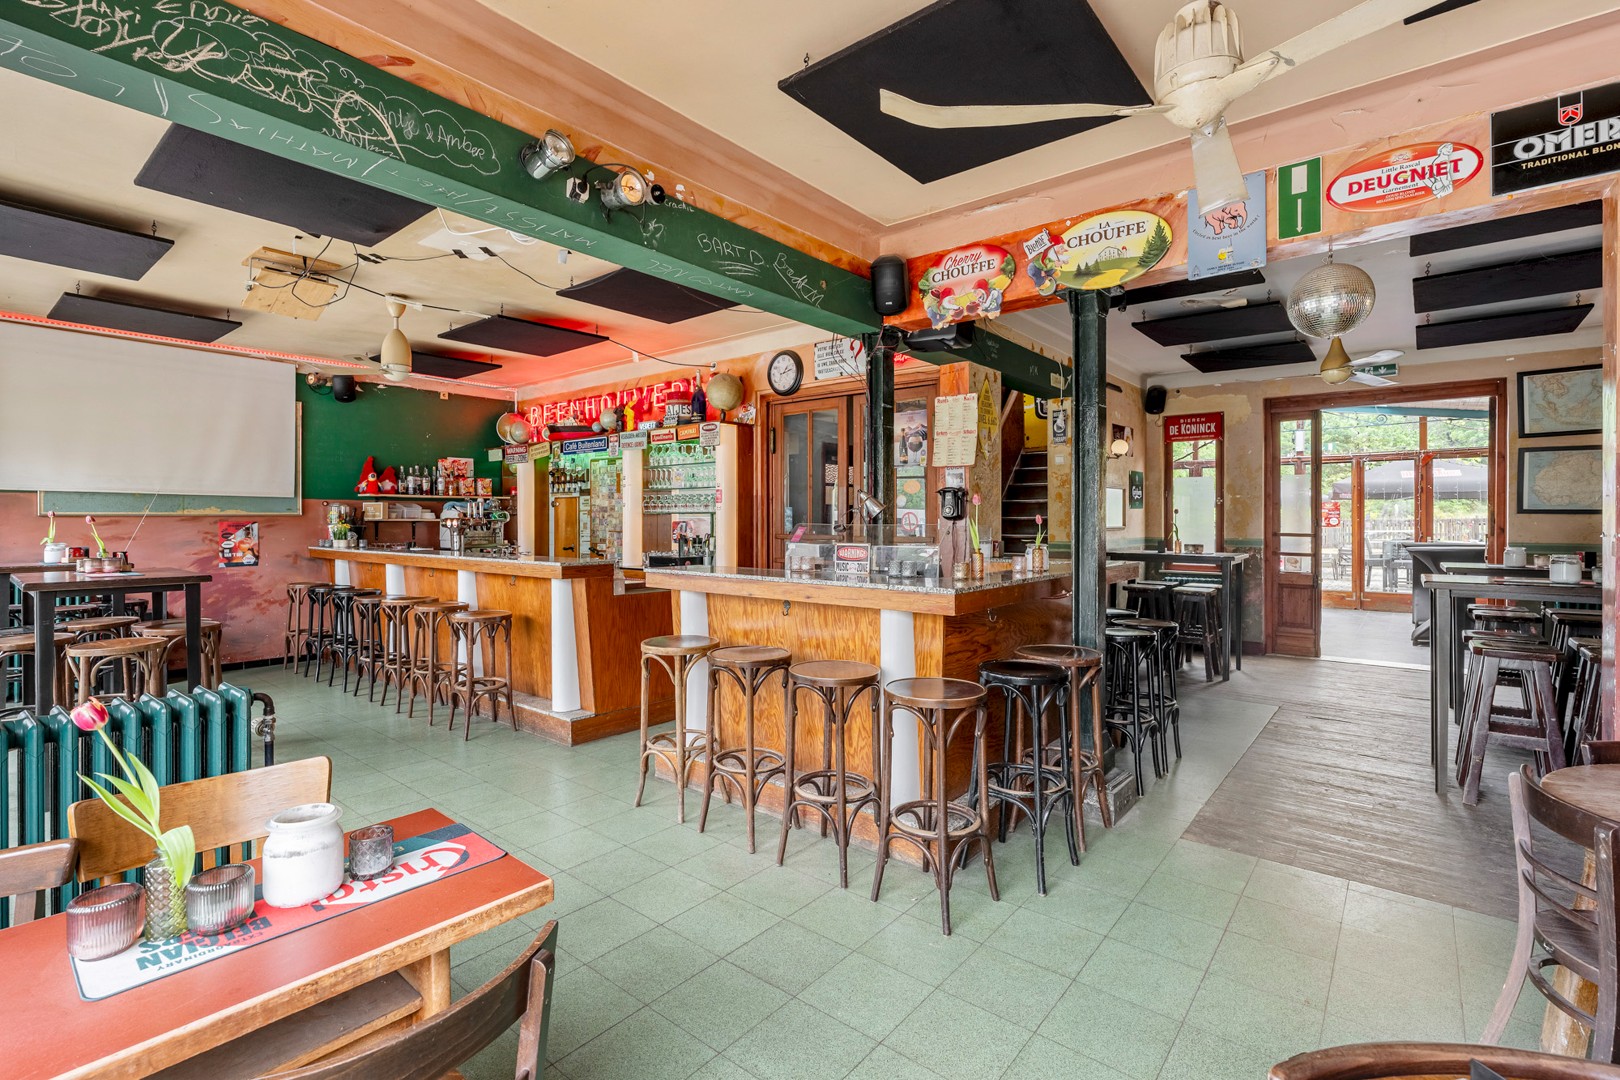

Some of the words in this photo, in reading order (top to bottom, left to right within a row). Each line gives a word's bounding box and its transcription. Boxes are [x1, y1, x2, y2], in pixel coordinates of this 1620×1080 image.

[1381, 164, 1399, 175] Little
[1400, 160, 1422, 171] Rascal
[1520, 150, 1590, 170] TRADITIONAL
[1348, 157, 1464, 197] DEUGNIET
[1066, 220, 1148, 249] CHOUFFE
[1099, 221, 1112, 231] LA
[697, 232, 746, 258] BART
[931, 258, 997, 284] CHOUFFE
[943, 250, 983, 271] Cherry
[1169, 425, 1179, 436] DE
[1181, 422, 1217, 435] KONINCK
[565, 442, 577, 451] Café
[578, 440, 605, 450] Buitenland
[312, 846, 466, 906] Crista
[156, 931, 264, 972] EXTRAORDINARY
